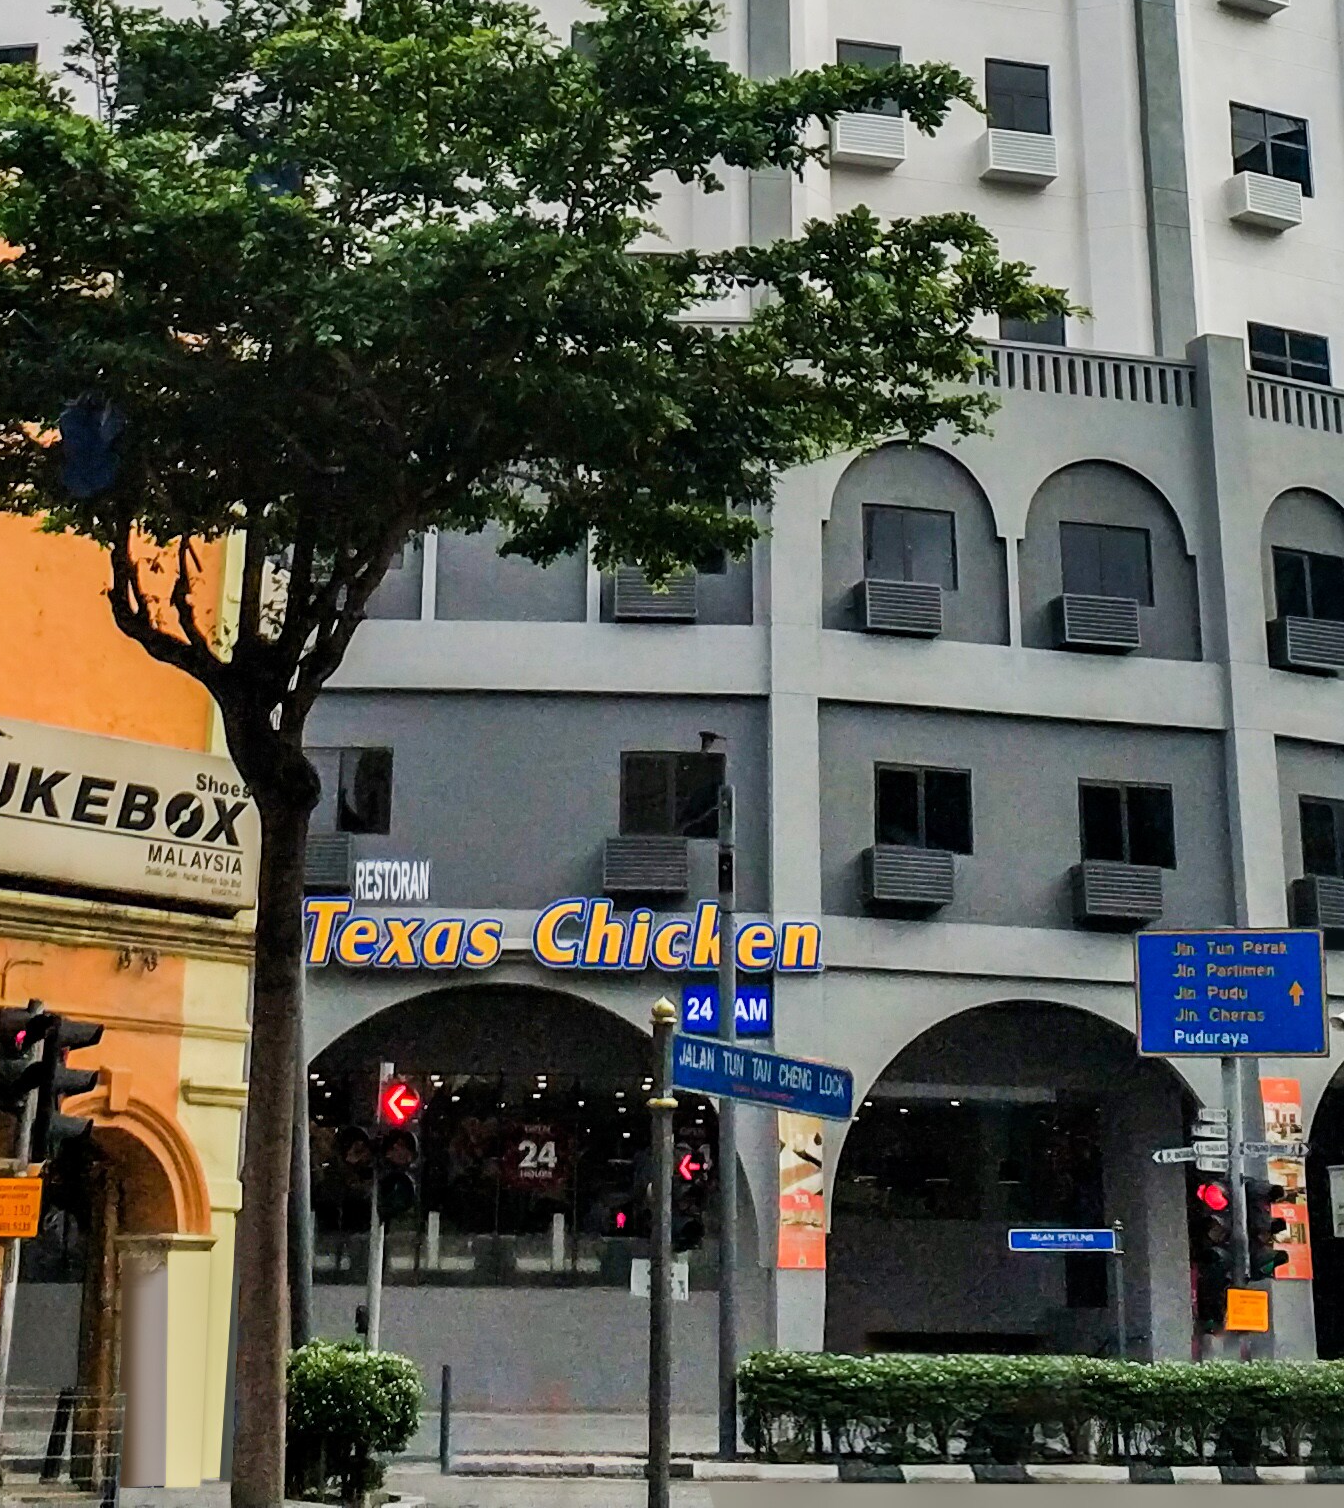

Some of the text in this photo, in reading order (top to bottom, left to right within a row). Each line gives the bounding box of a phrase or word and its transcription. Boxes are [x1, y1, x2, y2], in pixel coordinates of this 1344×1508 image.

[147, 844, 242, 875] MALAYSIA
[356, 861, 430, 900] RESTORAN
[302, 896, 822, 972] Texas Chicken
[1207, 941, 1234, 955] Tun
[1242, 941, 1288, 955] Perak
[1208, 985, 1248, 1000] Pudu
[687, 997, 767, 1021] 24 AM
[1209, 1008, 1265, 1022] Cheras
[1174, 1029, 1249, 1047] Puduraya
[679, 1043, 715, 1072] JALAN
[723, 1050, 745, 1077] TUN
[753, 1057, 772, 1083] TAN
[779, 1063, 812, 1092] CHENG
[819, 1071, 845, 1098] LOCK
[517, 1140, 557, 1168] 24
